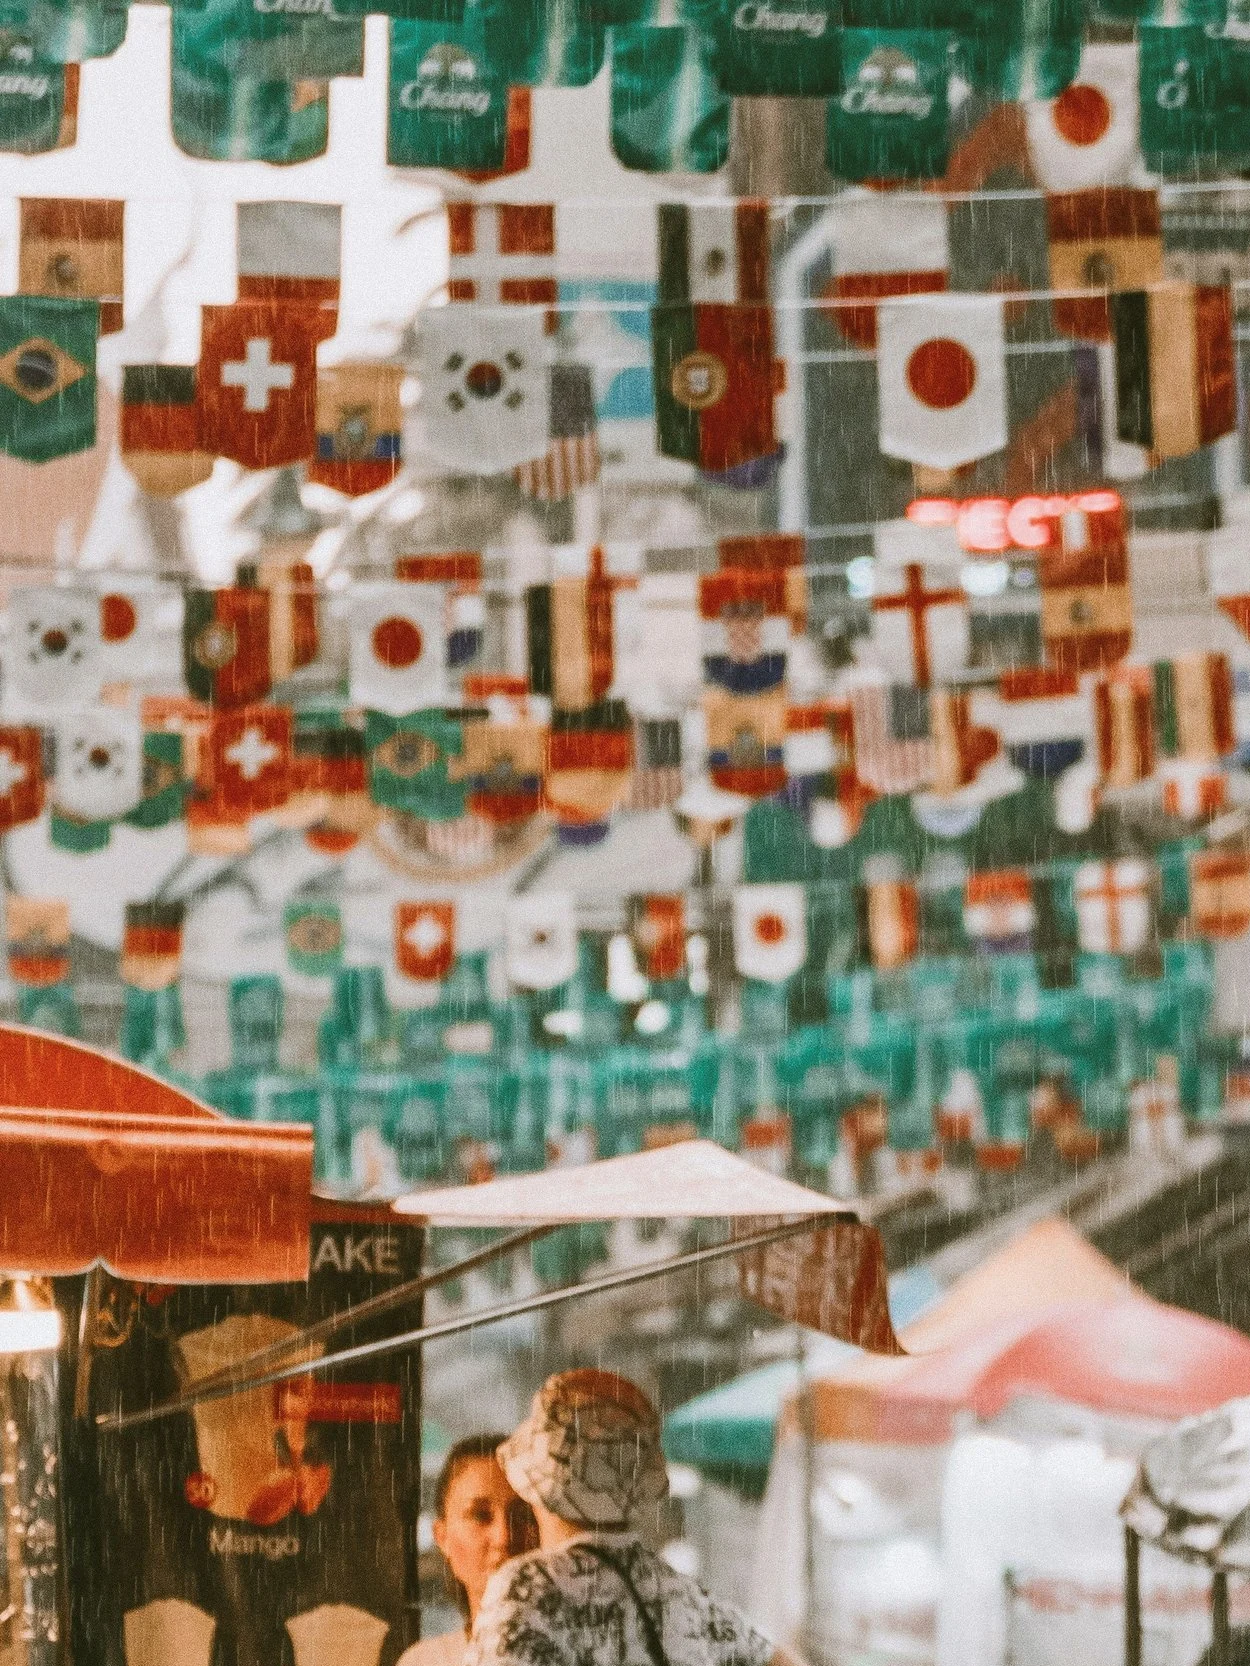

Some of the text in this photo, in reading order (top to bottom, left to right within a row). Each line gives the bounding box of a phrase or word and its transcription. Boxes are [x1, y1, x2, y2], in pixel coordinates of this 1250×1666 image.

[401, 79, 490, 117] Chang
[841, 89, 933, 121] Chang
[311, 1235, 400, 1273] AKE
[210, 1526, 300, 1560] Mango
